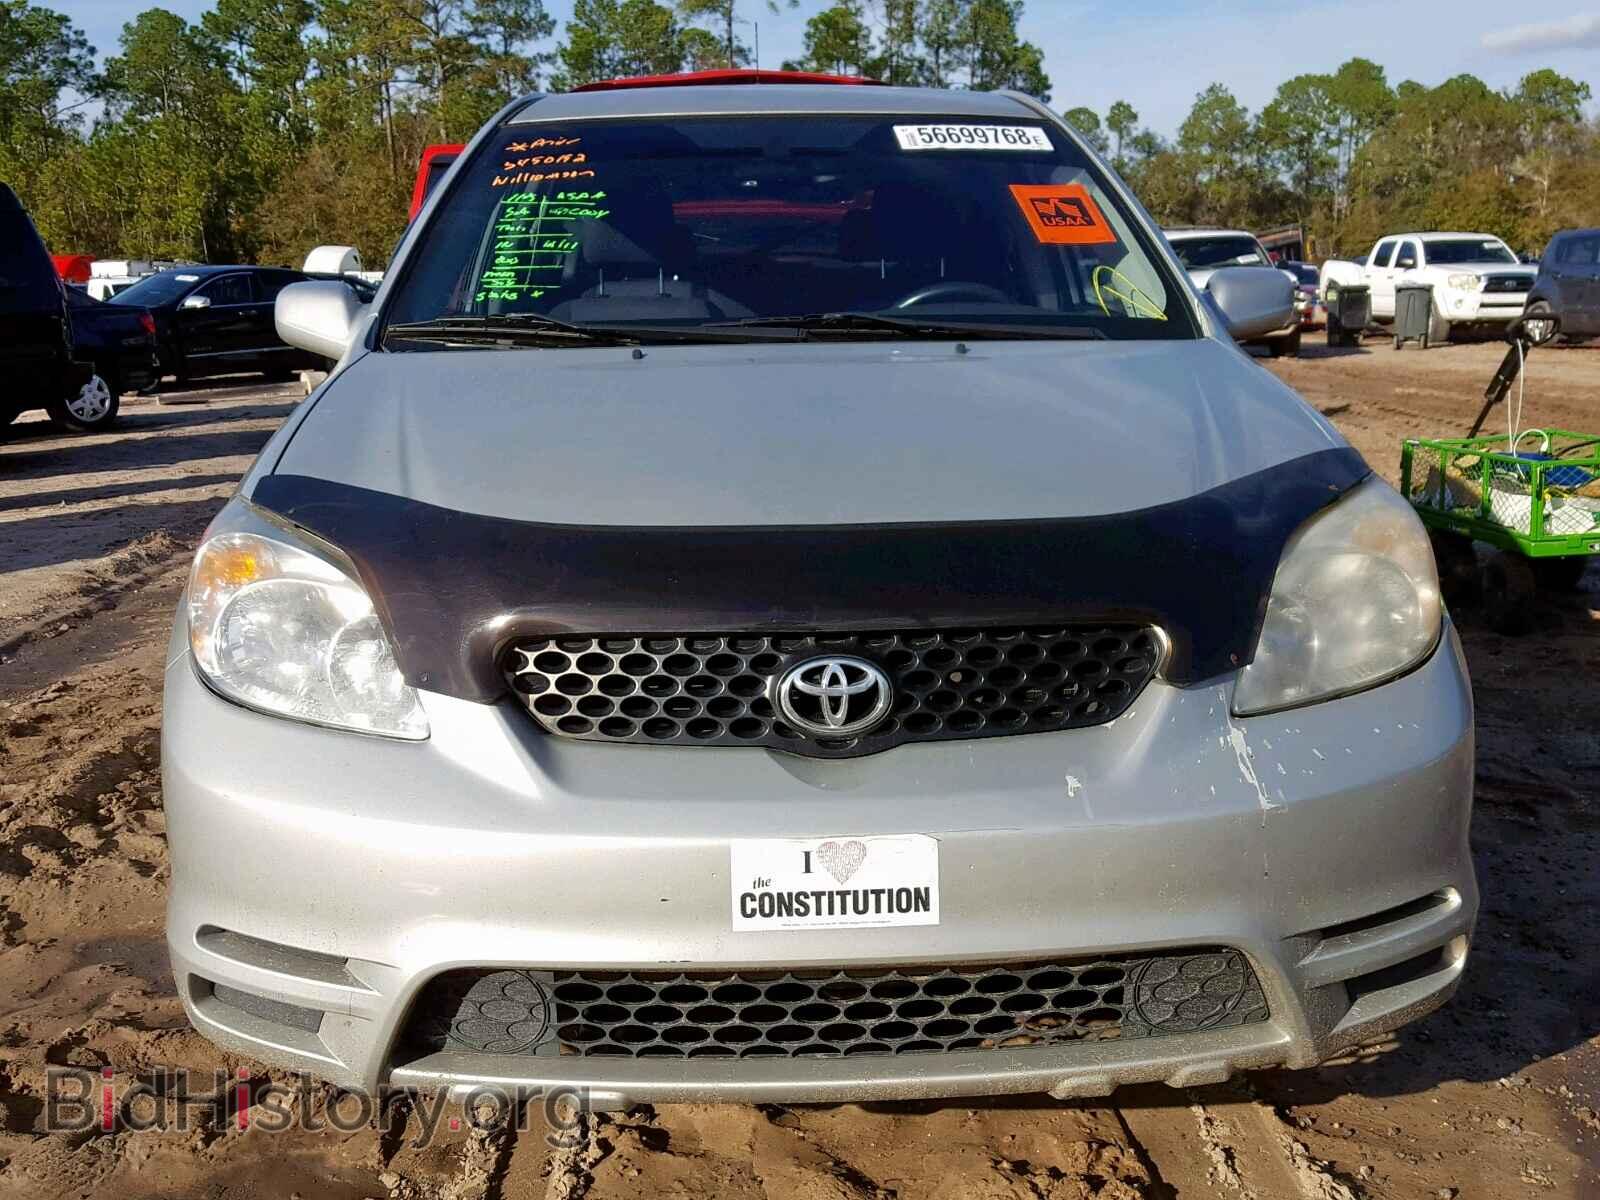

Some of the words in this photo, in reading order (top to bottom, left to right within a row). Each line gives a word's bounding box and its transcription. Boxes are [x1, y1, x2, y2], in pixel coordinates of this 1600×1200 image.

[917, 127, 1031, 145] 56699768
[1043, 216, 1088, 226] USAA
[801, 850, 815, 874] I
[752, 876, 773, 890] the
[740, 886, 931, 919] CONSTITUTION
